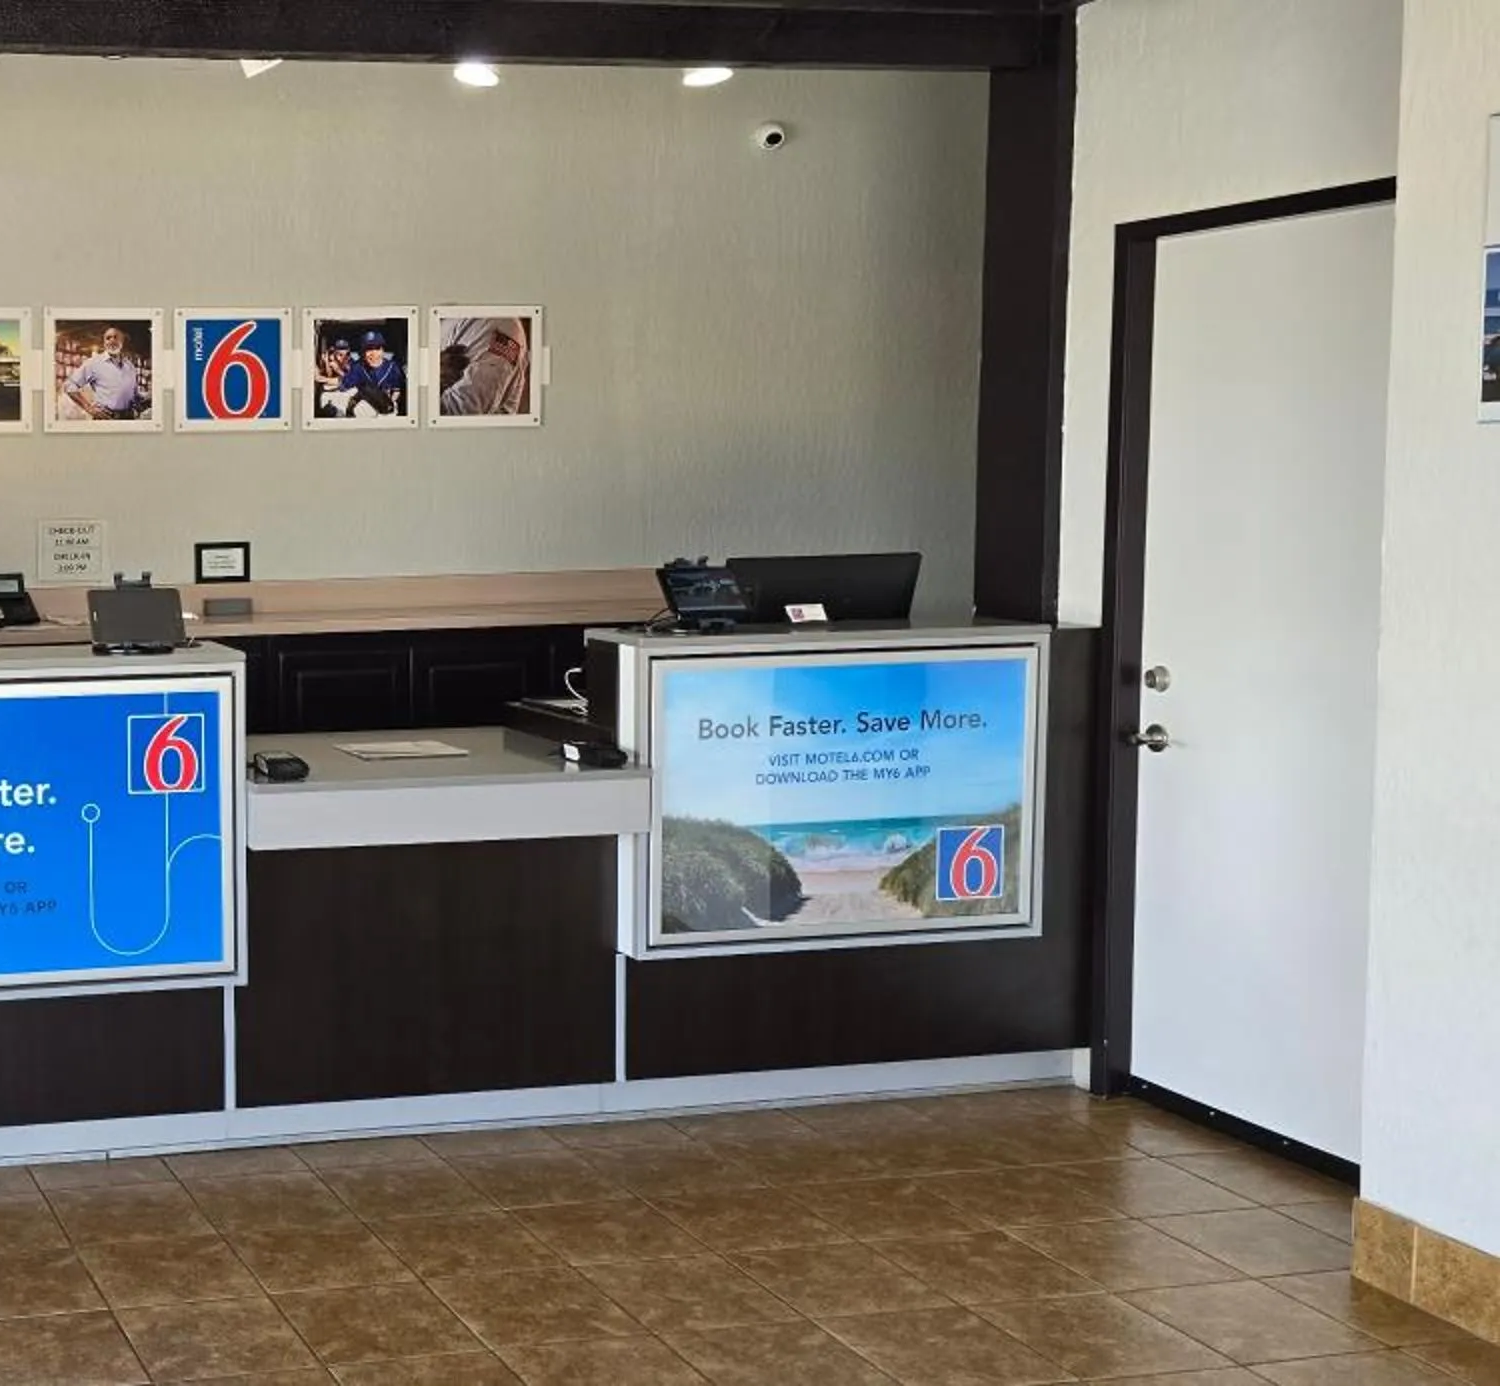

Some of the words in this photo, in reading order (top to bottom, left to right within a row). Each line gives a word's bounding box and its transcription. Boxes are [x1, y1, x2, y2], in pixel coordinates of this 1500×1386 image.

[192, 328, 204, 361] motel
[201, 320, 270, 421] 6
[699, 717, 760, 740] Book
[769, 715, 846, 737] Faster.
[856, 711, 910, 733] Save
[920, 709, 987, 730] More.
[143, 714, 199, 792] 6
[769, 753, 800, 767] VISIT
[805, 750, 894, 765] MOTEL6.COM
[900, 748, 919, 761] OR
[756, 769, 838, 785] DOWNLOAD
[843, 769, 868, 781] THE
[873, 767, 900, 780] MY6
[905, 766, 930, 778] APP
[949, 826, 998, 899] 6
[4, 881, 27, 894] OR
[25, 900, 57, 912] APP
